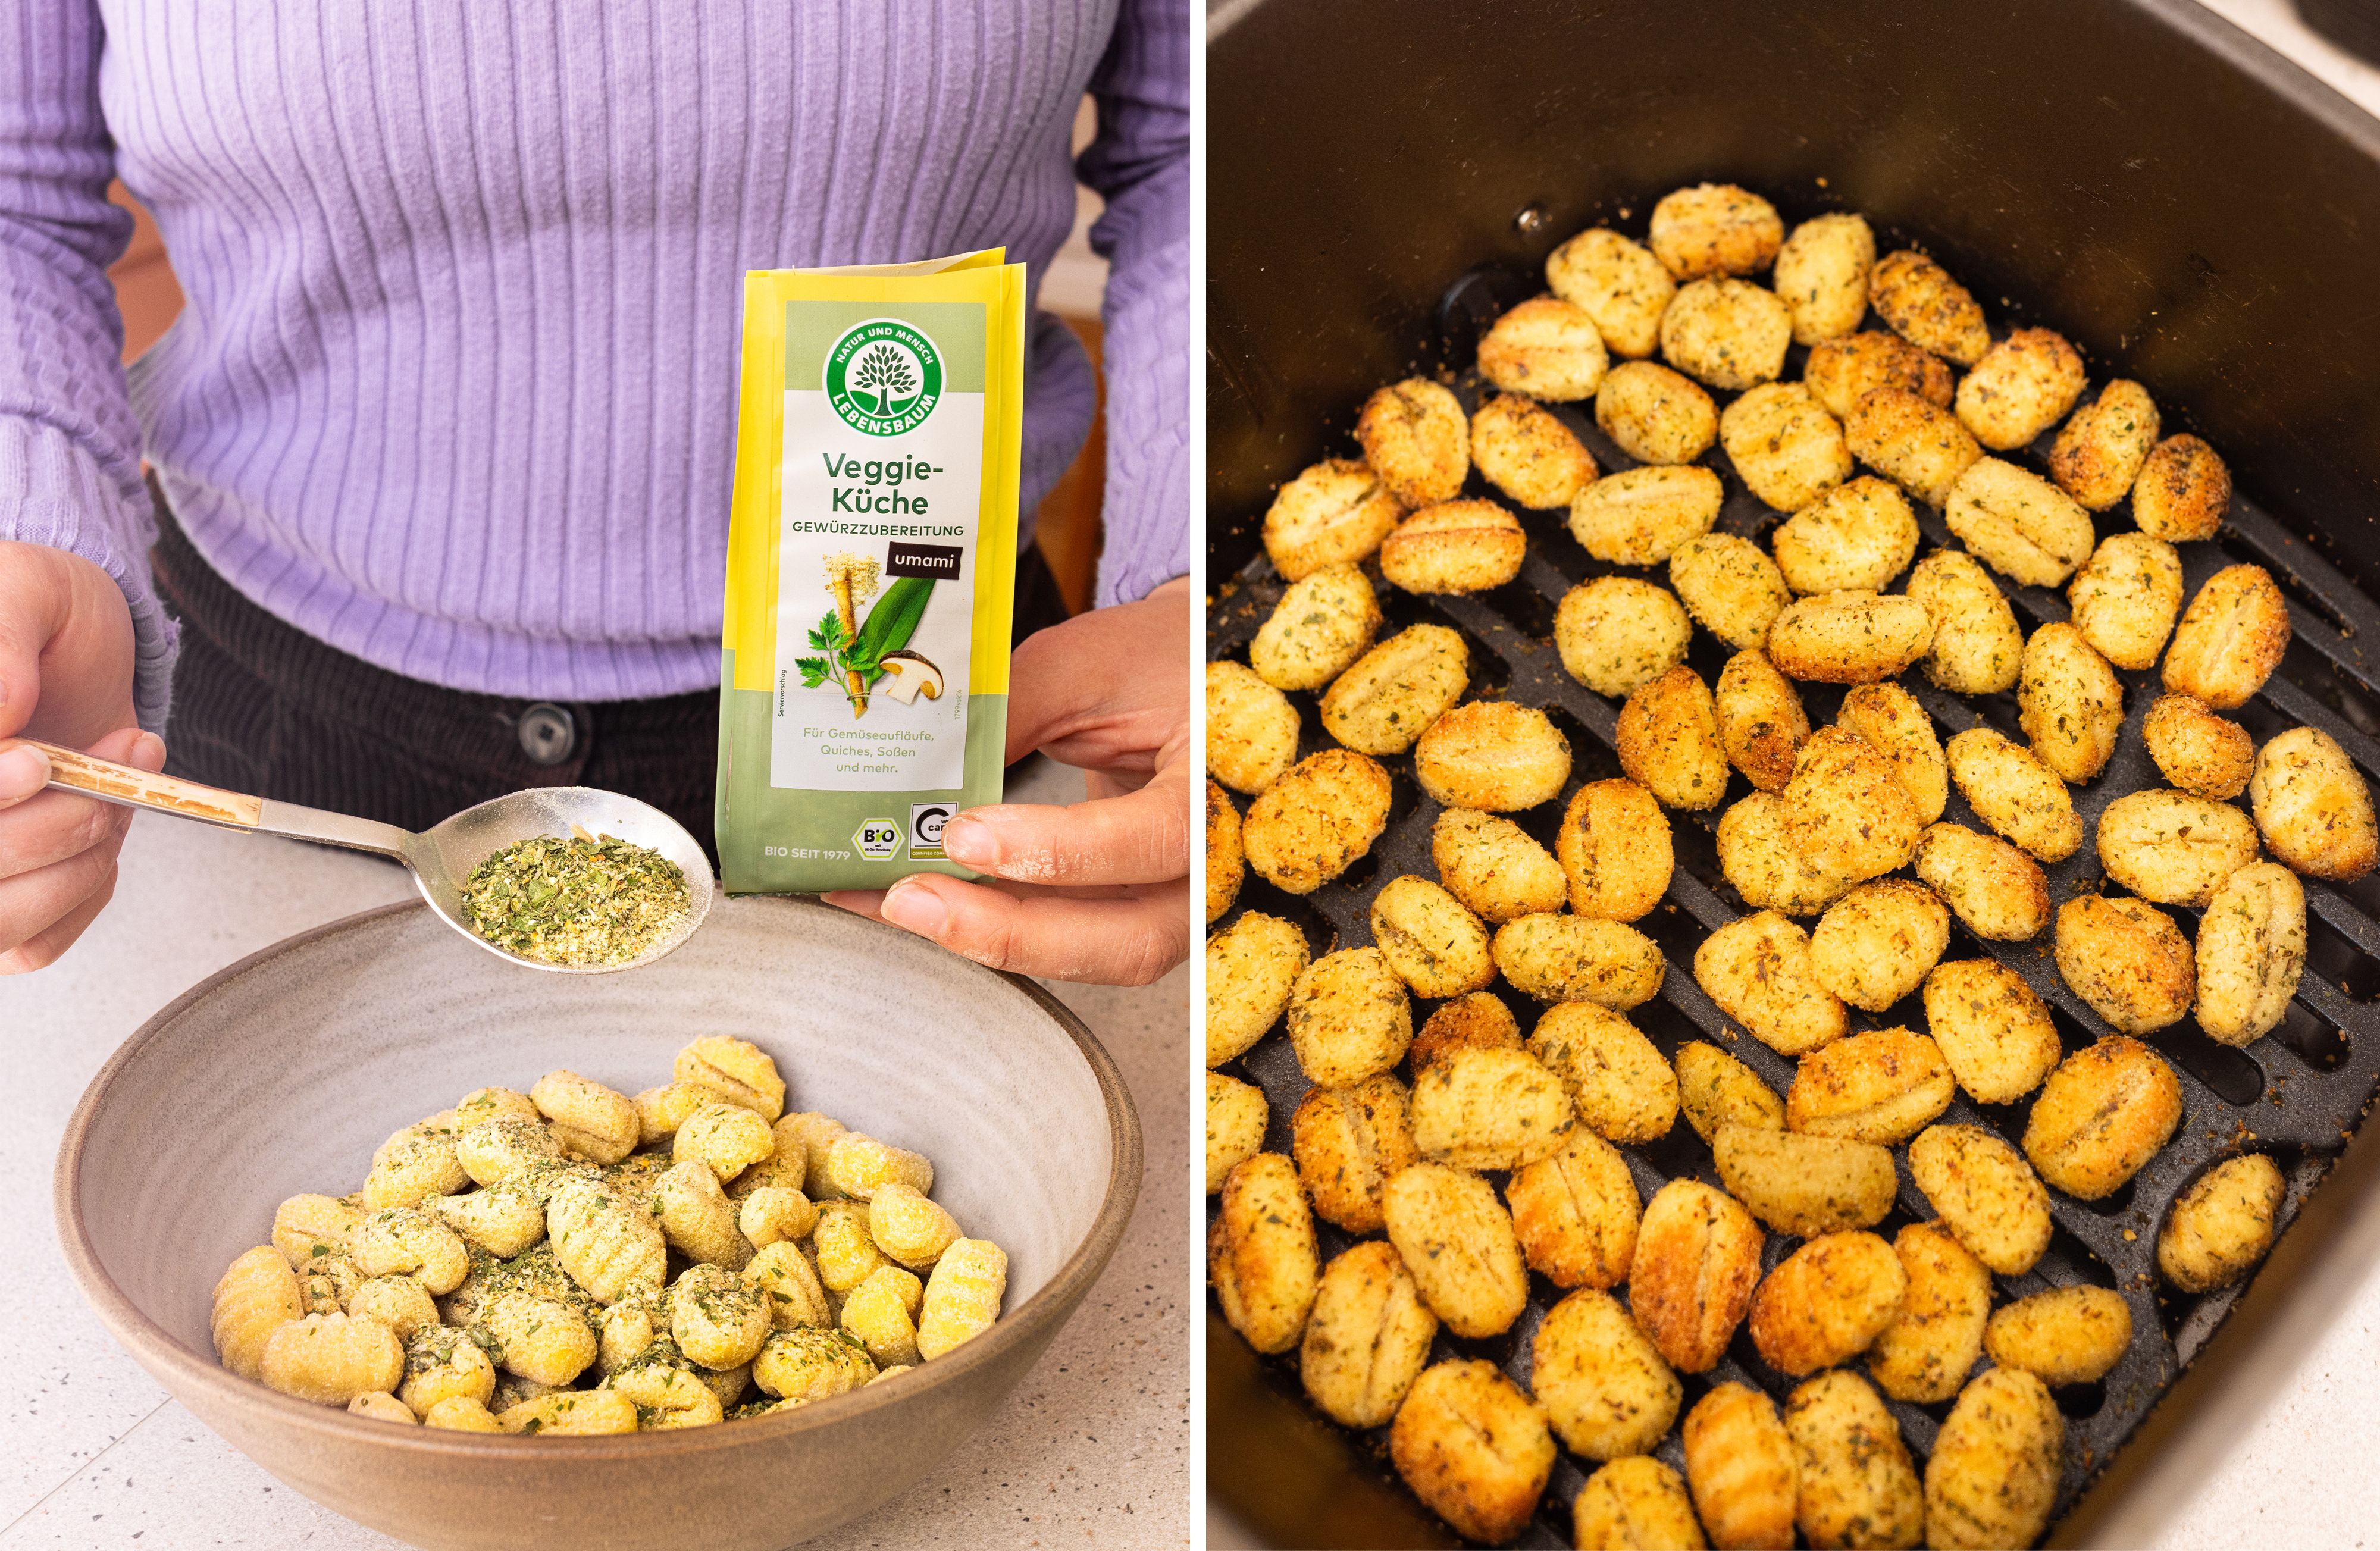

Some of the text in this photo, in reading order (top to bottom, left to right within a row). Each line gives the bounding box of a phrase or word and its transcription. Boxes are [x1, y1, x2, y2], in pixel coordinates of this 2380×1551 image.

[836, 327, 934, 365] NATUR UND MENSCH
[832, 393, 936, 434] LEBENSBAUM
[822, 452, 944, 486] Veggie-
[832, 487, 928, 515] Küche
[792, 519, 964, 536] GEWÜRZZUBEREITUNG
[895, 554, 954, 568] umami
[778, 670, 787, 717] Serviervorschlag
[803, 727, 934, 741] Für Gemüseaufläufe,
[821, 745, 915, 757] Quiches, Soßen
[837, 762, 898, 773] und mehr.
[765, 846, 851, 860] BIO SEIT 1979
